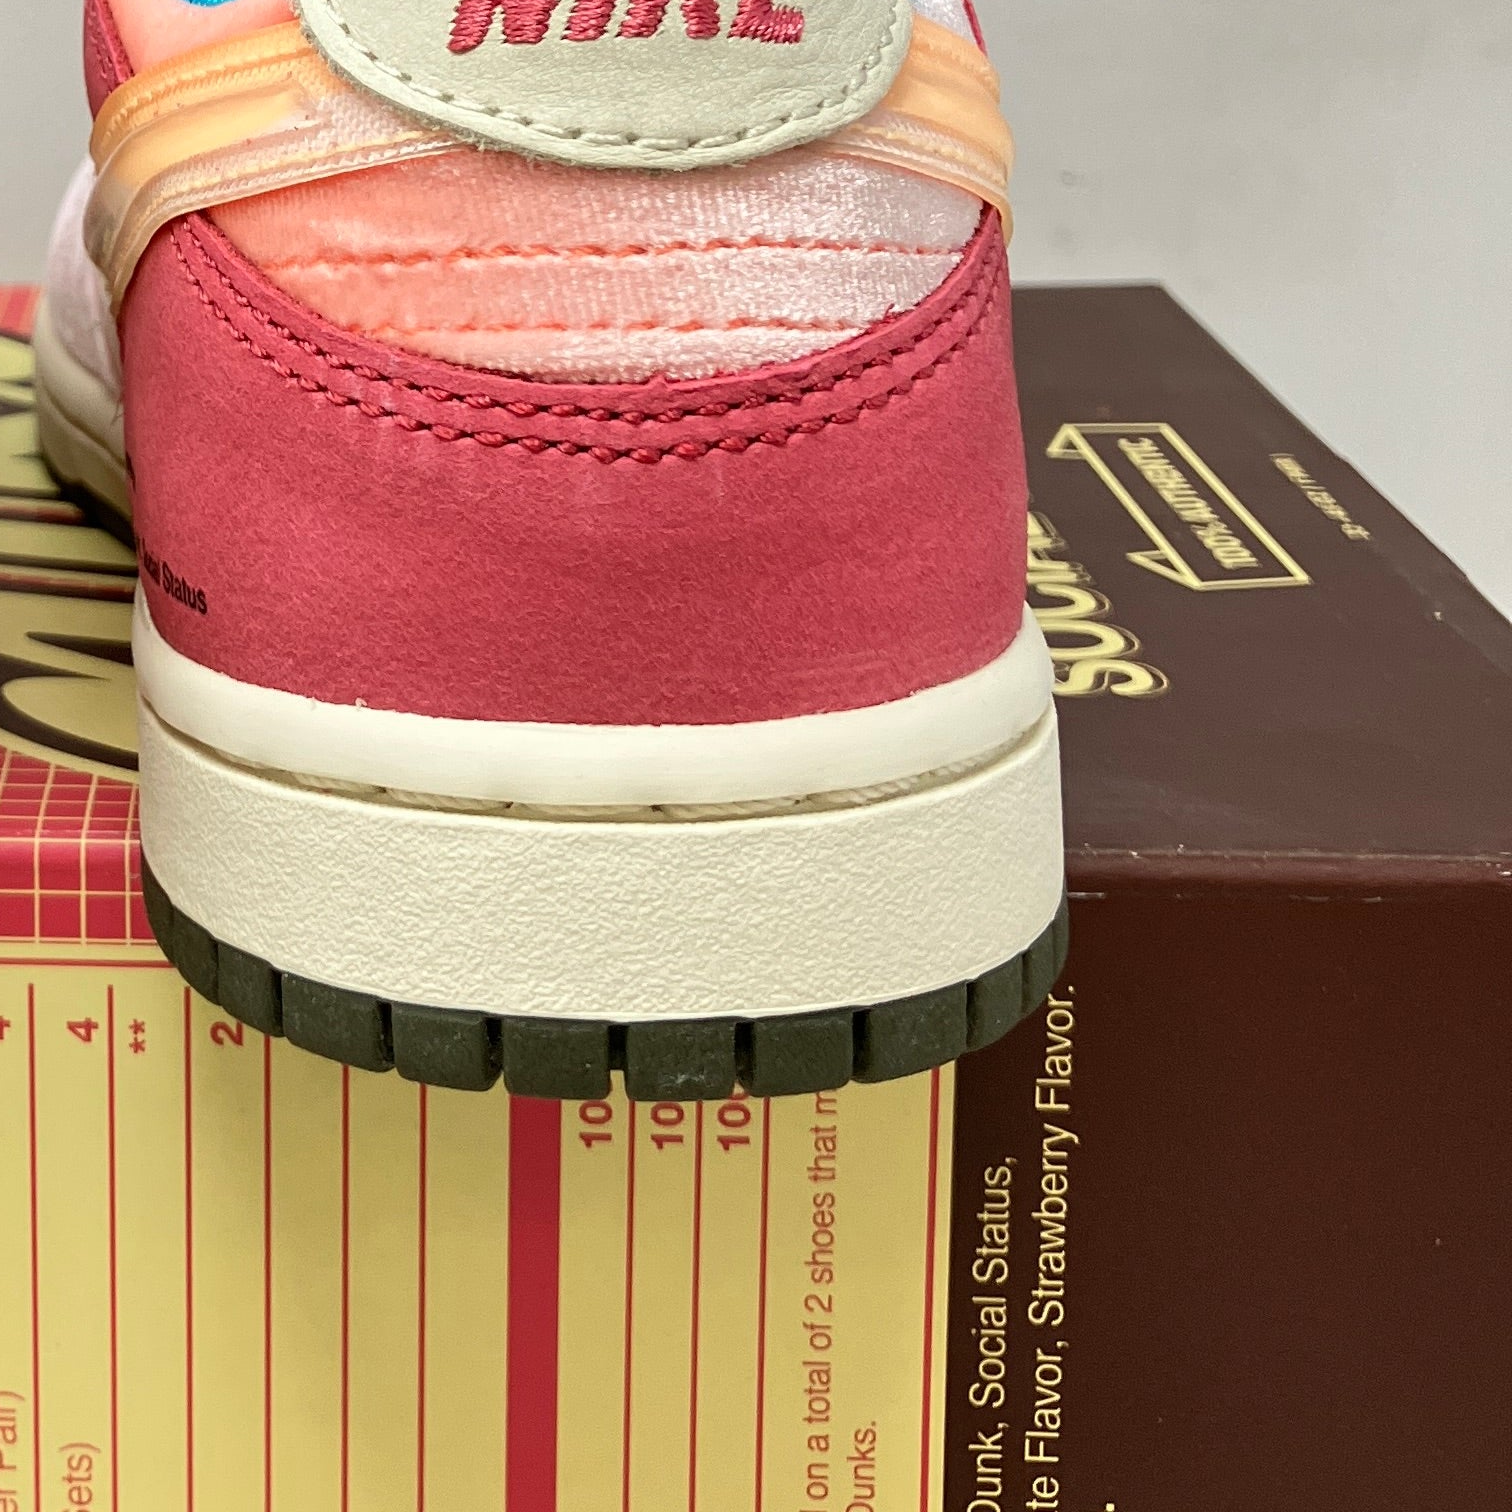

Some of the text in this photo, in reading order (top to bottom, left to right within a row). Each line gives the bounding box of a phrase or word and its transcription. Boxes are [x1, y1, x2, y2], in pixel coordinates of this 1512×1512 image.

[1117, 437, 1220, 522] AUTHENTIC
[161, 560, 208, 615] Status
[67, 1016, 99, 1043] 4
[211, 1021, 243, 1046] 2
[1036, 986, 1075, 1112] Flavor.
[807, 1125, 838, 1181] that
[804, 1193, 836, 1285] shoes
[972, 1156, 1017, 1284] Status,
[1028, 1124, 1080, 1327] Strawberry
[804, 1294, 833, 1313] 2
[802, 1321, 831, 1350] of
[968, 1296, 1008, 1408] Social
[803, 1361, 831, 1423] total
[1024, 1340, 1068, 1464] Flavor,
[808, 1435, 829, 1452] a
[805, 1464, 829, 1500] on
